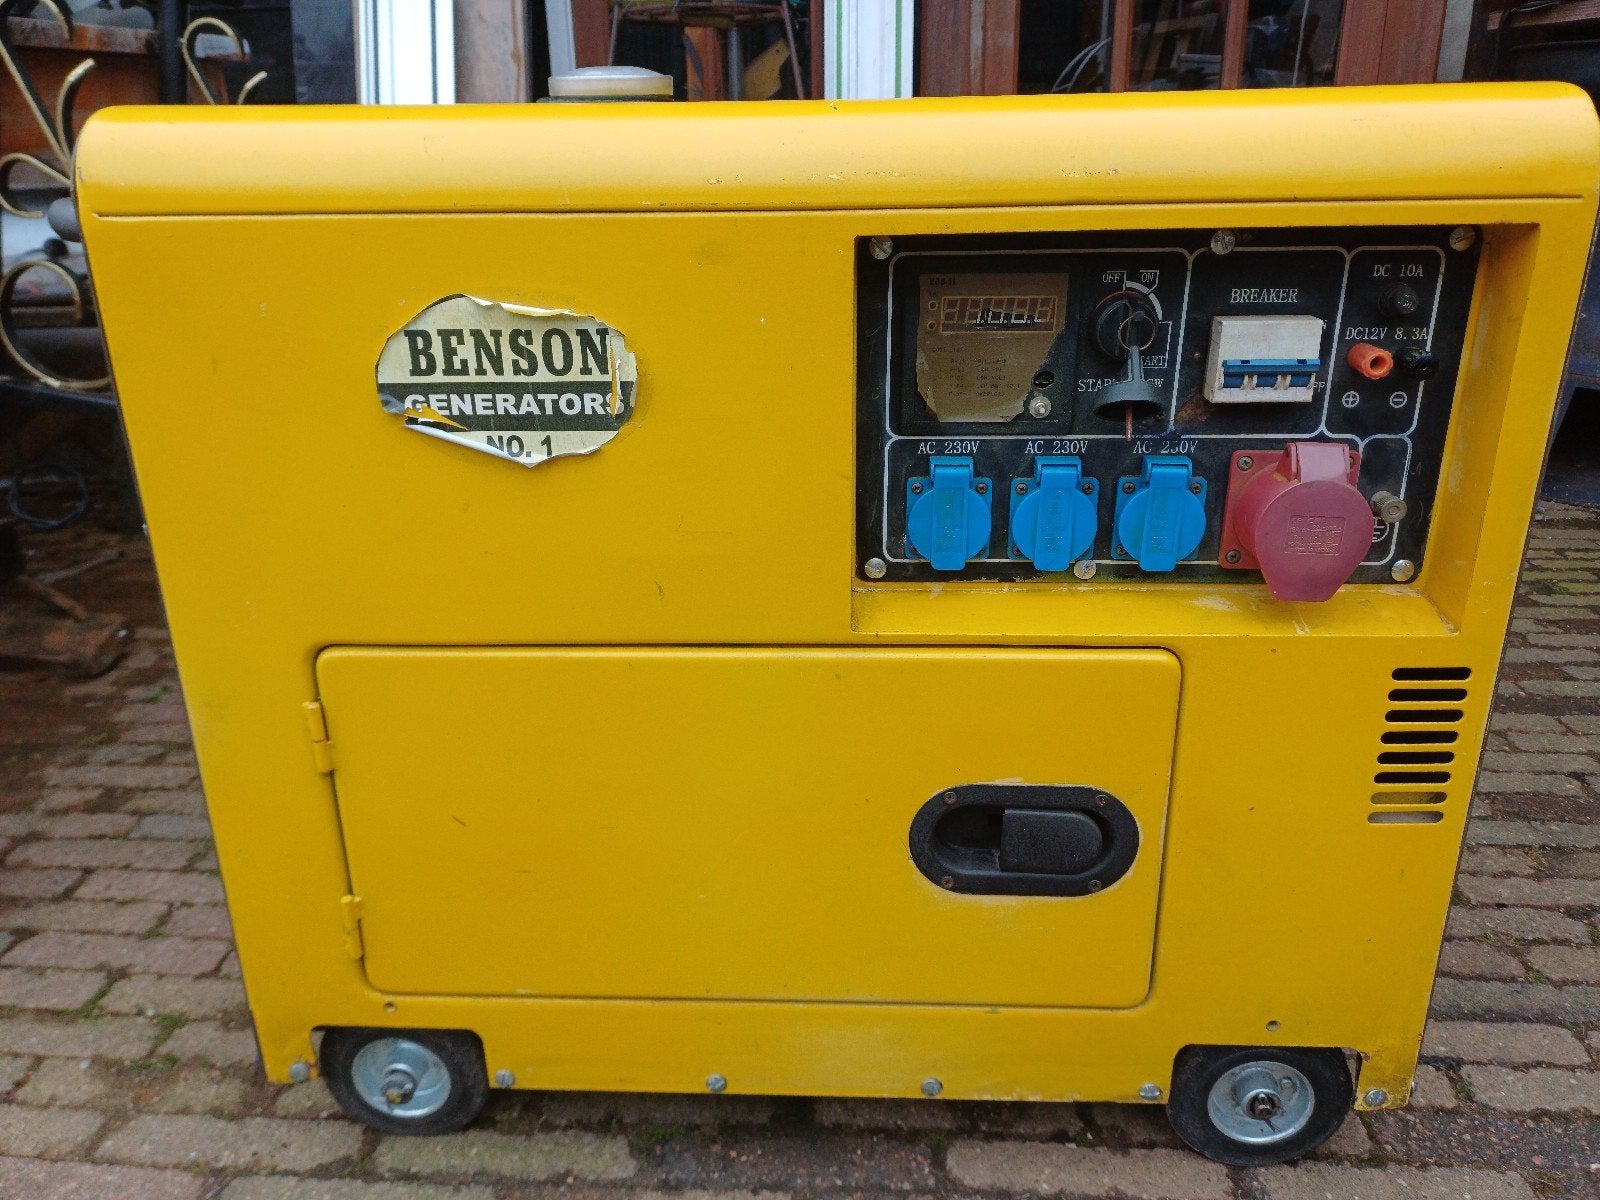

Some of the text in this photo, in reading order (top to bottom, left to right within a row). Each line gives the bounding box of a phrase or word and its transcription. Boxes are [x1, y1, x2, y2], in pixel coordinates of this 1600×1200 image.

[1103, 272, 1122, 283] OFF
[1141, 272, 1154, 283] ON
[1373, 264, 1424, 277] DC 10A
[1230, 288, 1299, 304] BREAKER
[1346, 327, 1428, 341] DC12V 8.3A
[404, 327, 609, 376] BENSON
[541, 435, 553, 458] 1
[918, 440, 980, 454] AC 230V
[1025, 440, 1089, 454] AC 230V
[1132, 440, 1152, 454] AC
